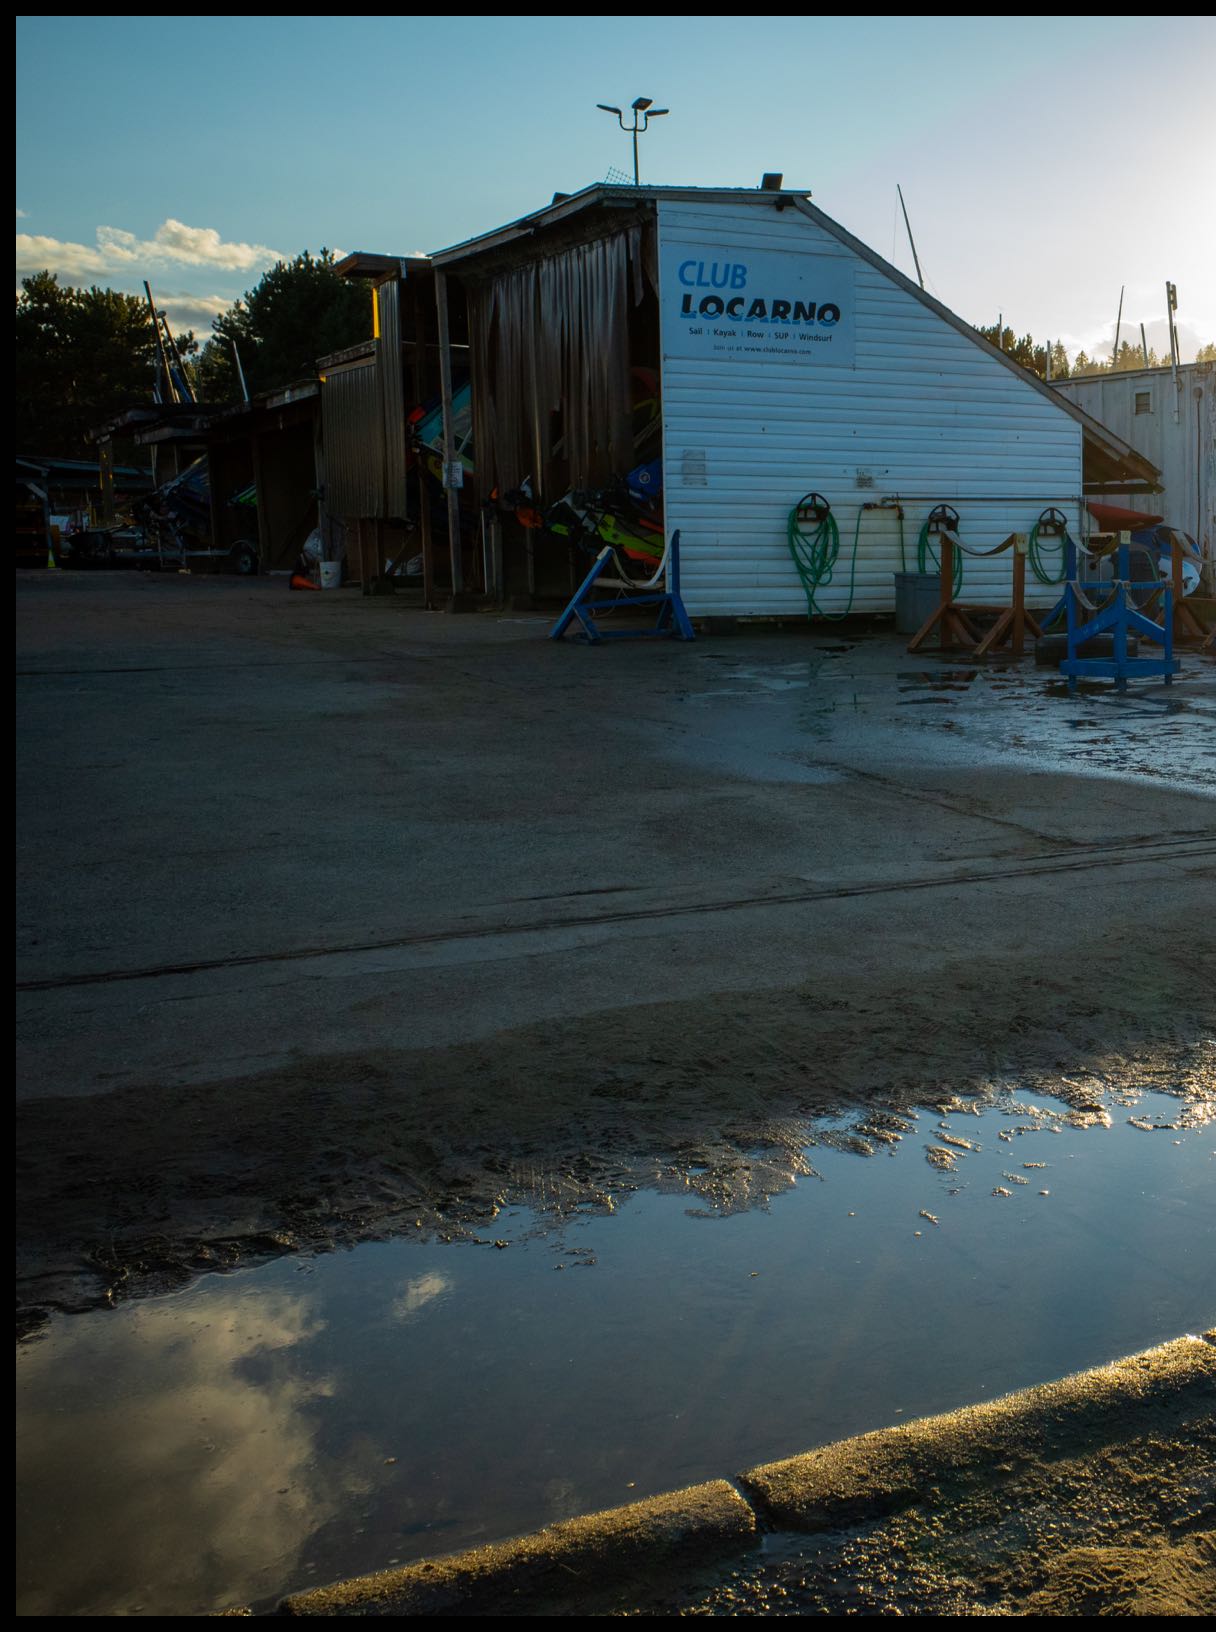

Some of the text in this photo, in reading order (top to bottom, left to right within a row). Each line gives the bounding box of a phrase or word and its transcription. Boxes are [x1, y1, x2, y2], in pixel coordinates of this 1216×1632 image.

[678, 260, 748, 289] CLUB
[679, 293, 841, 327] LOCARNO
[689, 327, 833, 342] Sail Kayak Row SUP Windsurf
